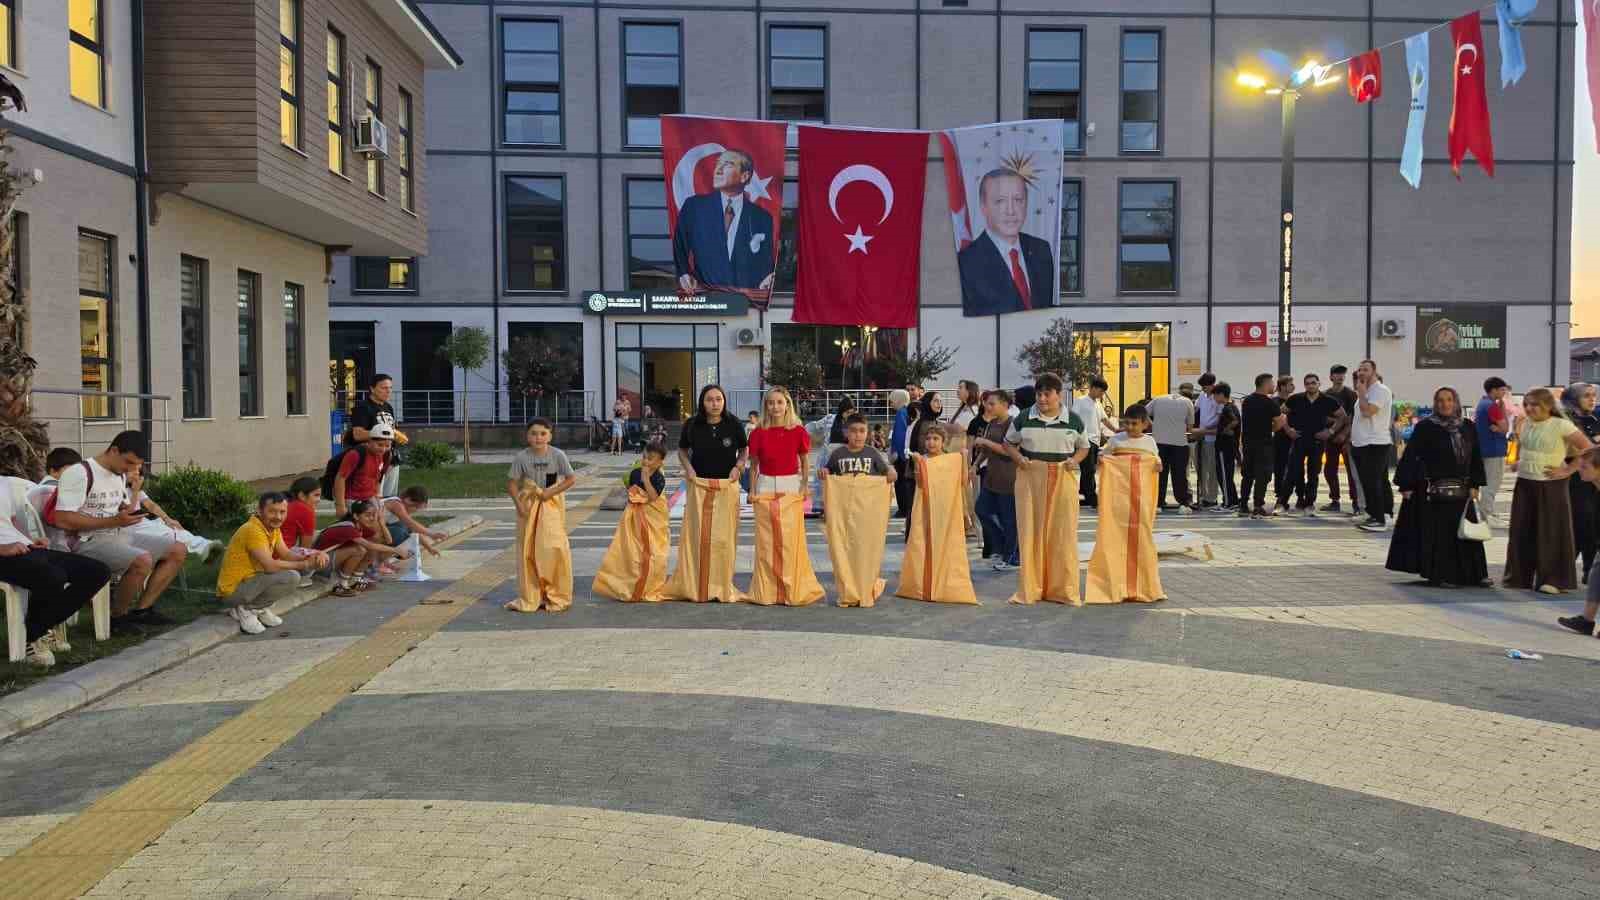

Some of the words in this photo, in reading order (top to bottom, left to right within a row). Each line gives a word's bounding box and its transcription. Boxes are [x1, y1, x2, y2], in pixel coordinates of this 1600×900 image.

[651, 295, 680, 303] SAKARYA
[1475, 337, 1500, 349] YERDE
[838, 457, 872, 473] UTAH
